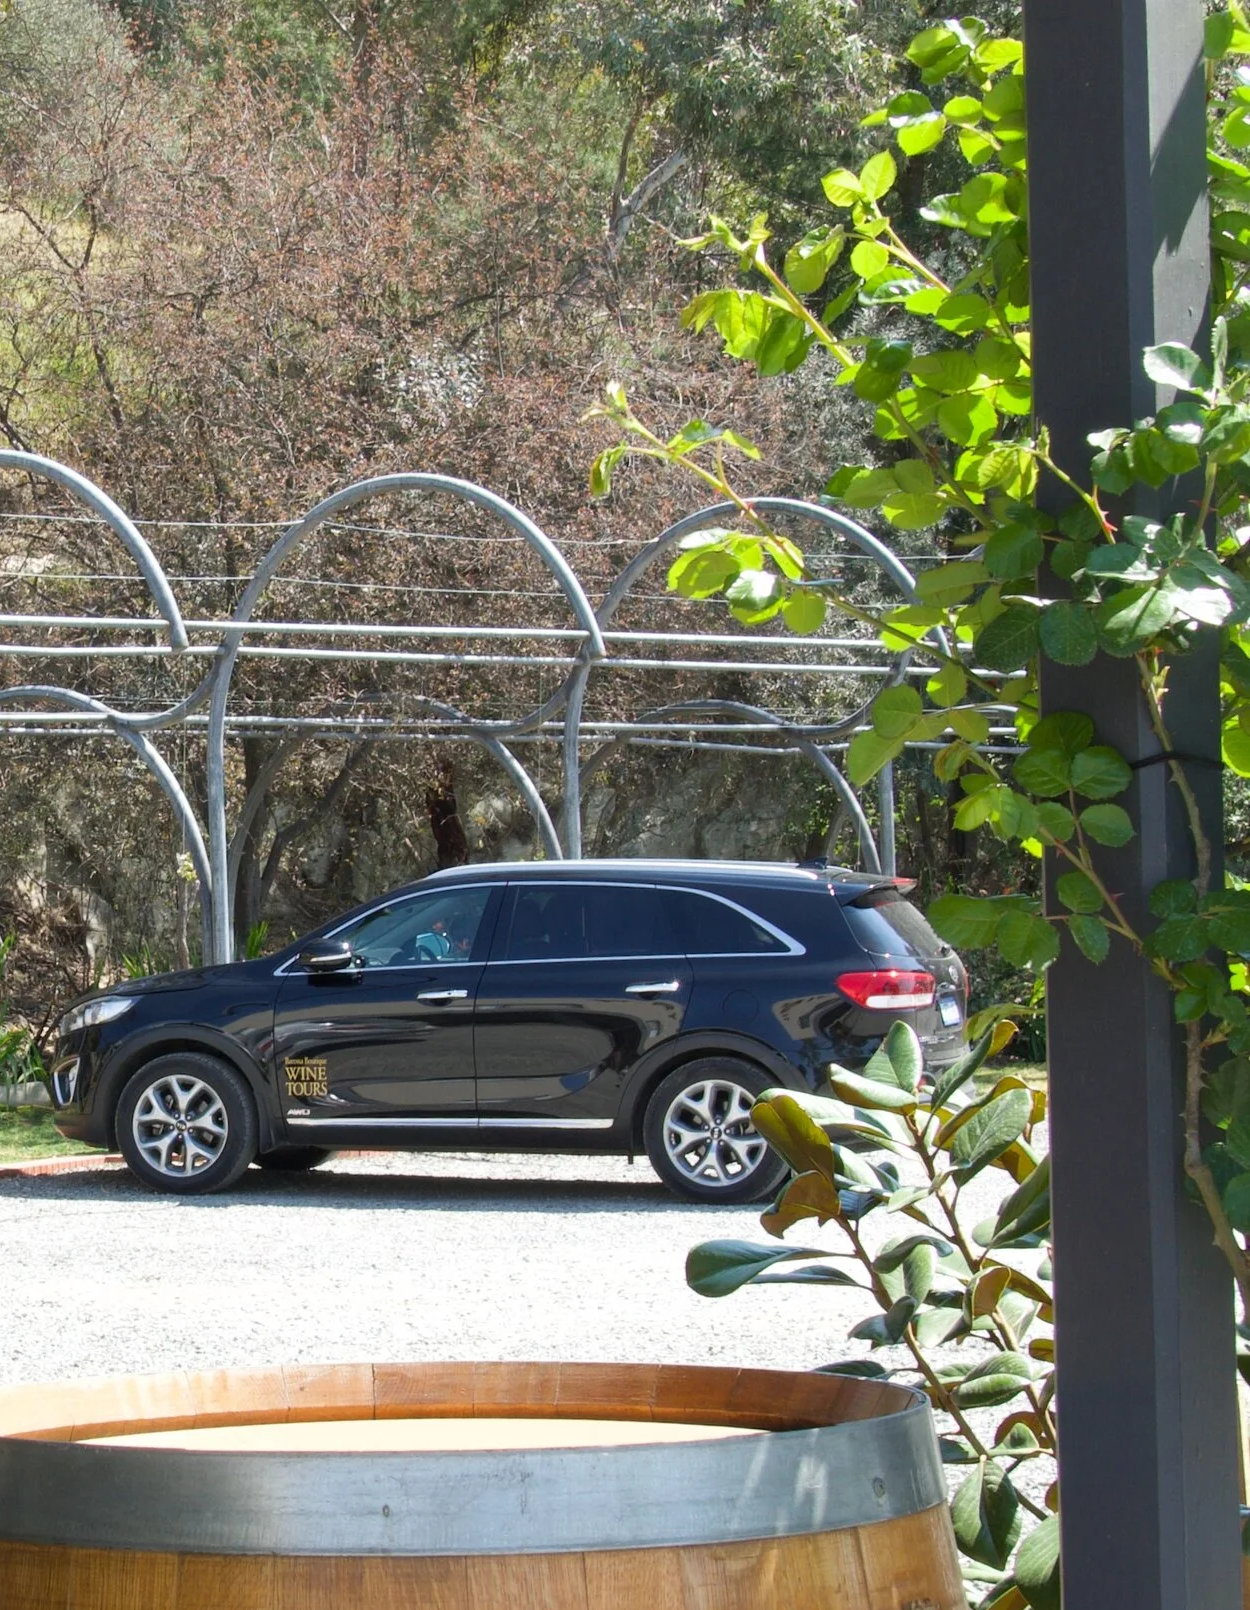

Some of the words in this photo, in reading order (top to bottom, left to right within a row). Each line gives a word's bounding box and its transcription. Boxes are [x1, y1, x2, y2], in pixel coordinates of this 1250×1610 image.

[285, 1067, 327, 1080] WINE
[285, 1081, 328, 1096] TOURS
[287, 1108, 311, 1116] AWD
